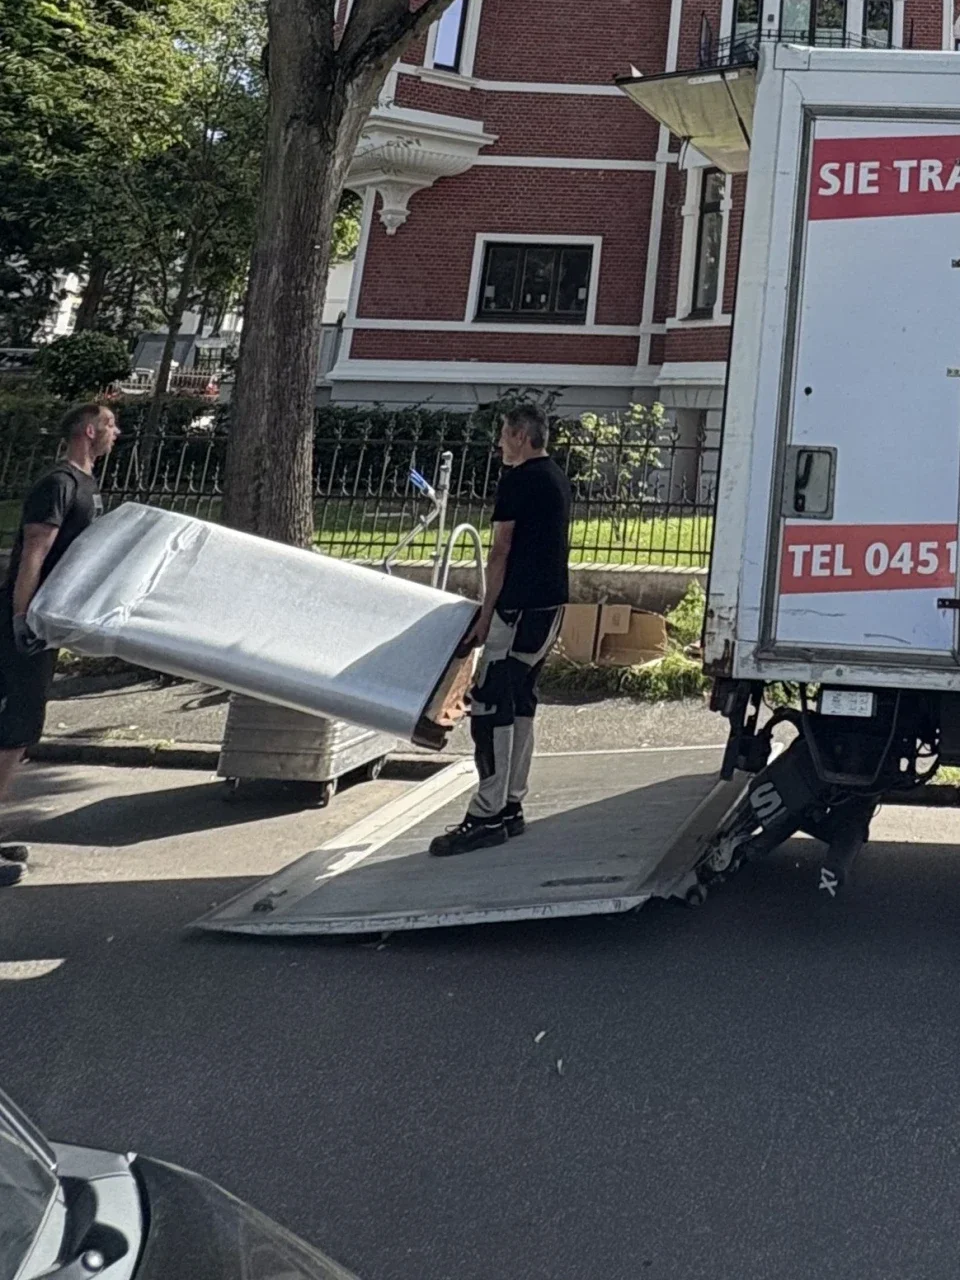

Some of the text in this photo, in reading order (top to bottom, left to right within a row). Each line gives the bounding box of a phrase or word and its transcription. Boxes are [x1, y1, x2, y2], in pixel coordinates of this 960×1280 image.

[818, 161, 880, 196] SIE
[788, 543, 853, 577] TEL
[864, 540, 957, 577] 0451
